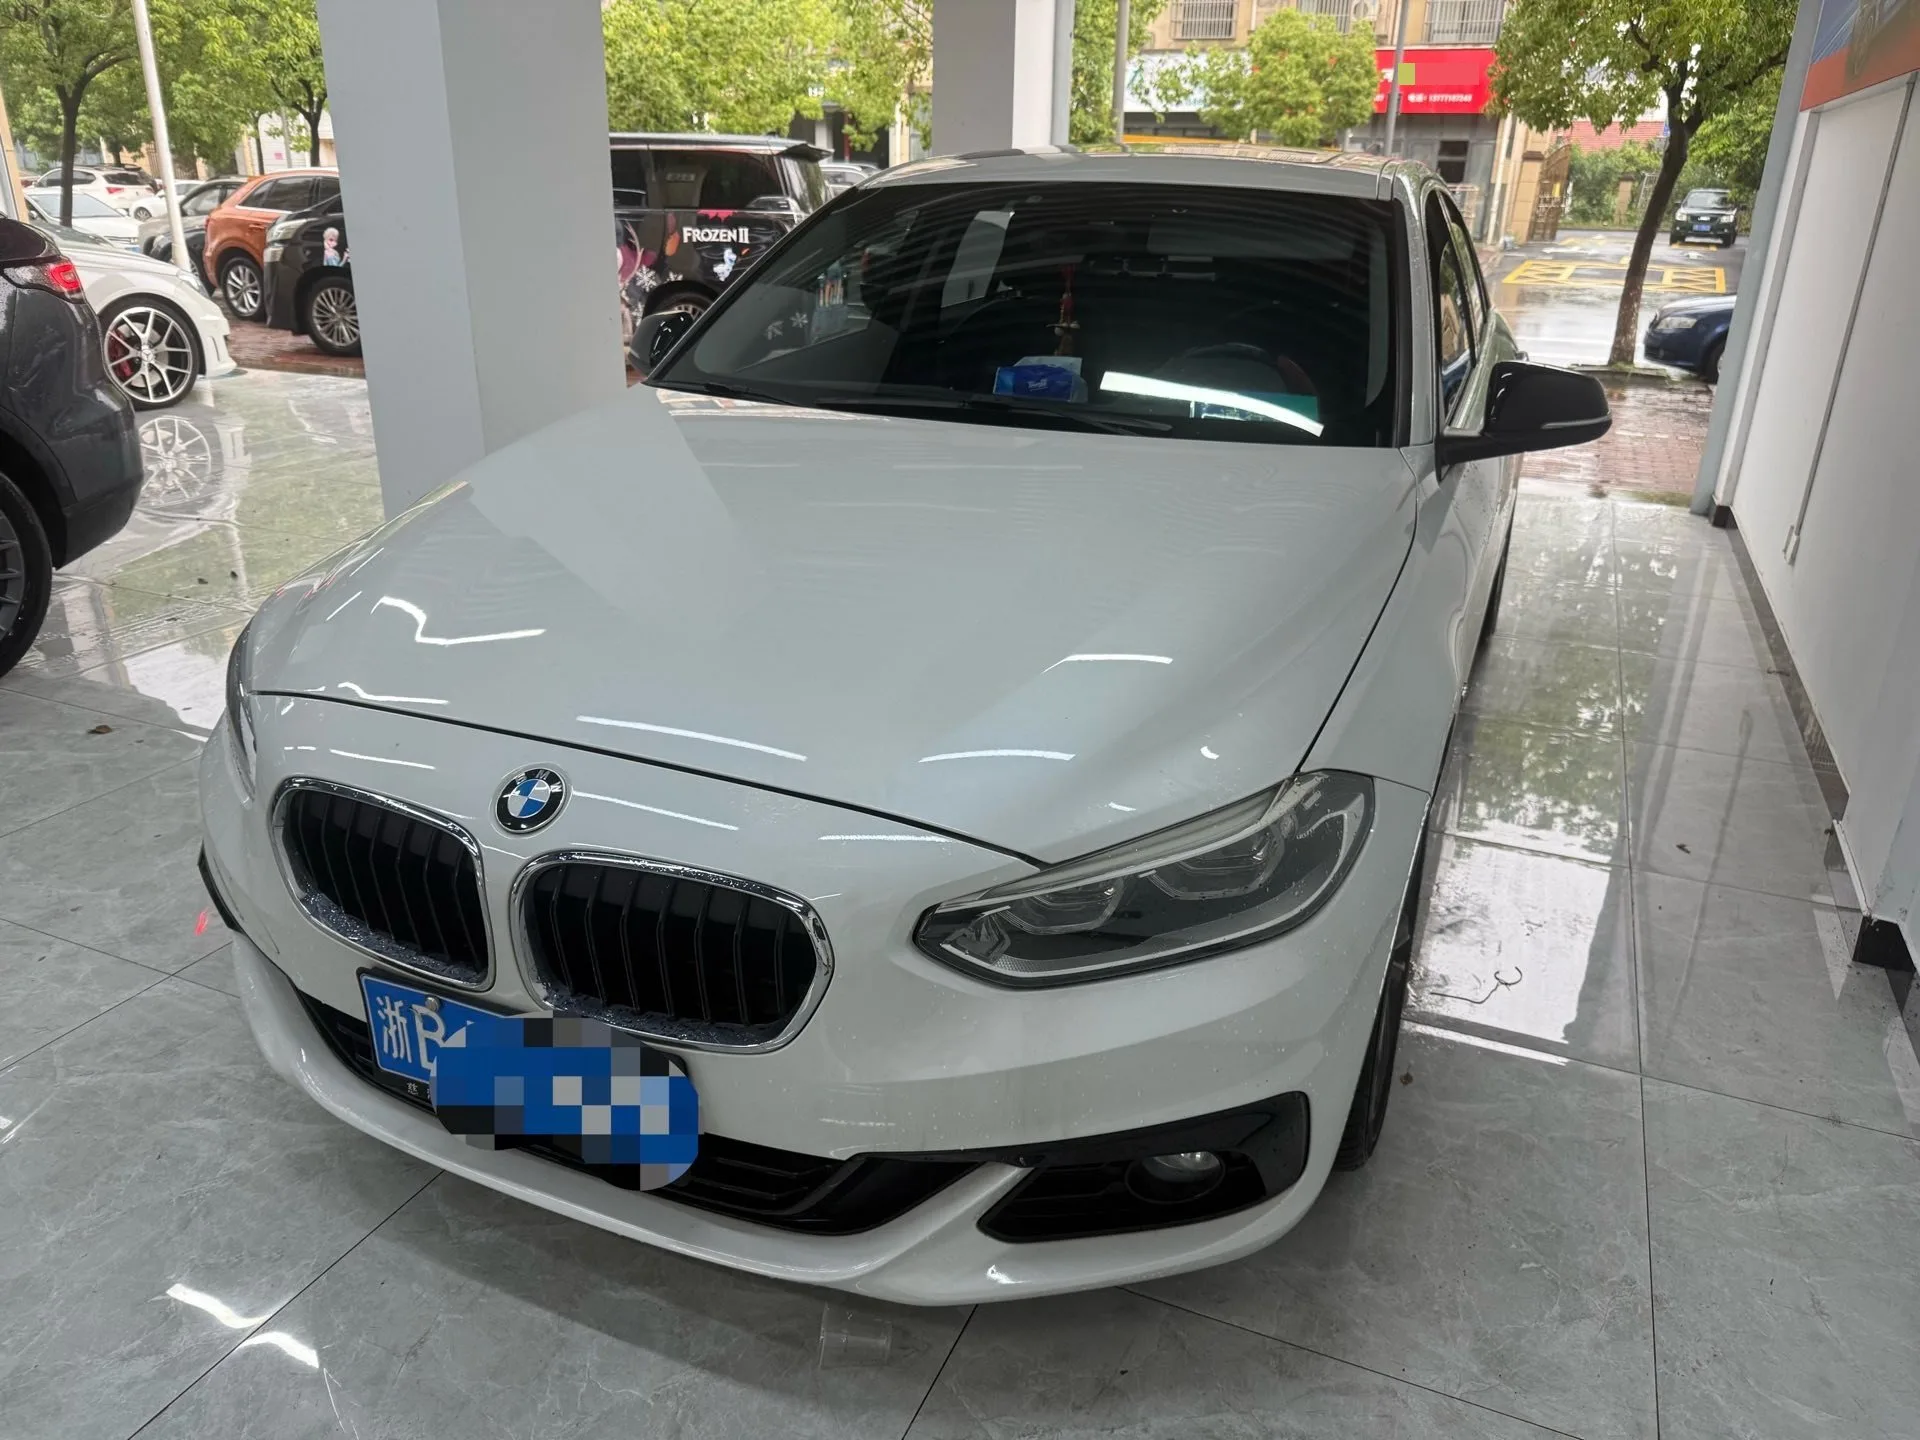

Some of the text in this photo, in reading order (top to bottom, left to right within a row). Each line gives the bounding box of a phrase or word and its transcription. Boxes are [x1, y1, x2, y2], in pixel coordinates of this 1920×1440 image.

[682, 226, 750, 244] FROZEN II
[515, 769, 562, 793] BMW
